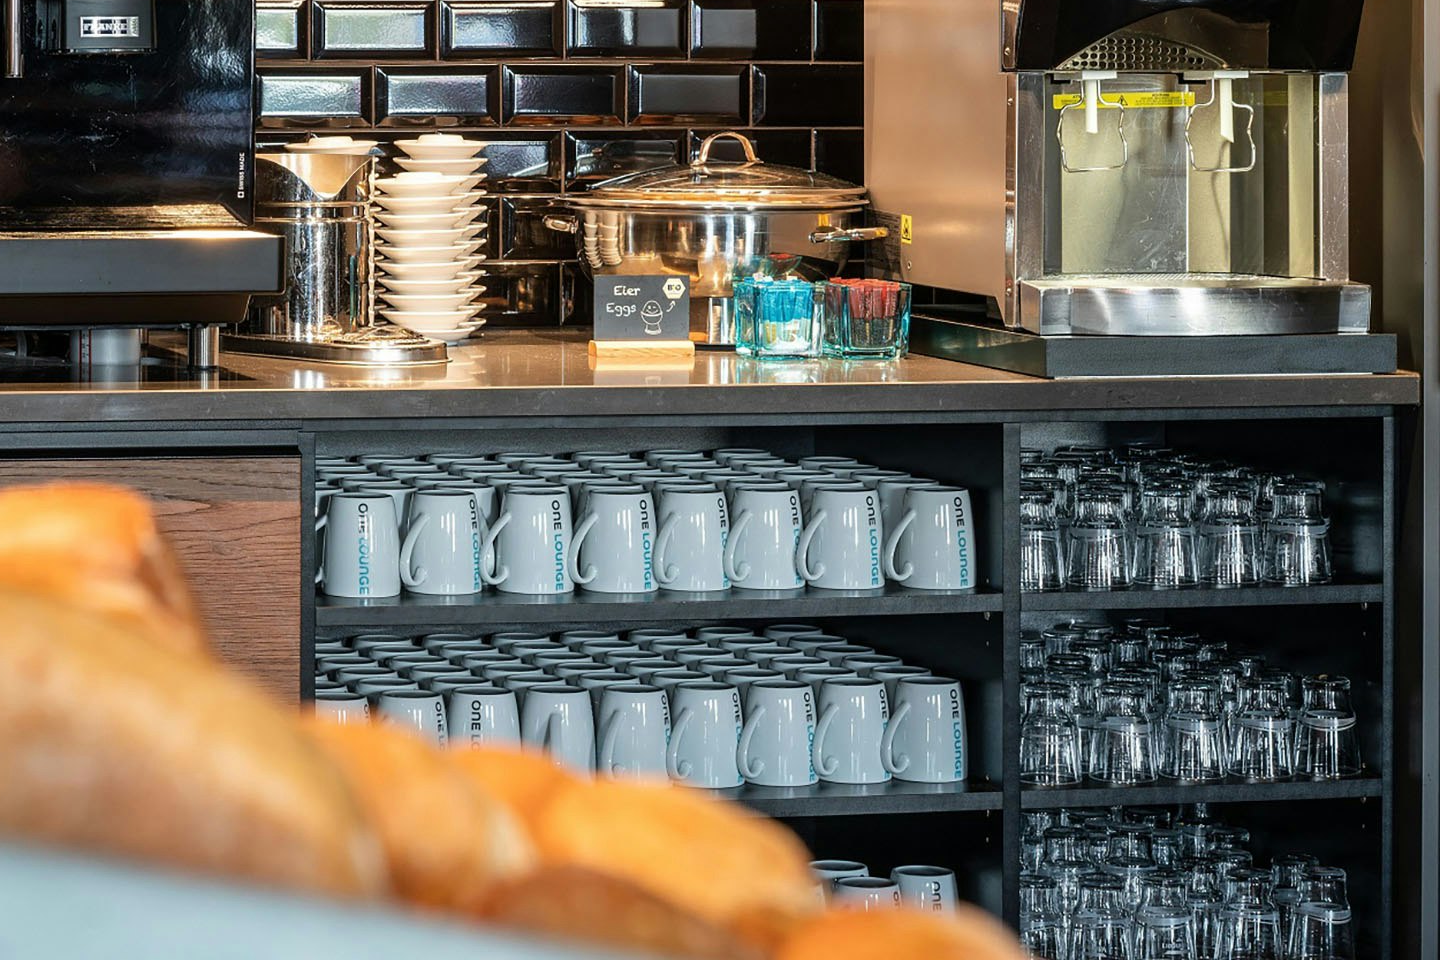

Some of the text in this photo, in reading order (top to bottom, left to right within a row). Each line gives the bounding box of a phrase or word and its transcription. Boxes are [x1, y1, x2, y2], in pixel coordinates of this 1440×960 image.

[613, 285, 640, 296] Eier
[606, 302, 637, 317] Eggs
[469, 499, 479, 530] ONE
[717, 497, 727, 528] ONE
[790, 495, 800, 526] ONE
[551, 499, 565, 591] ONE LOUNGE
[639, 499, 653, 590] ONE LOUNGE
[866, 496, 880, 587] ONE LOUNGE
[953, 496, 969, 587] ONE LOUNGE
[471, 700, 481, 731] ONE
[661, 694, 670, 725] ONE
[732, 692, 742, 723] ONE
[803, 692, 813, 722] ONE
[879, 689, 889, 719] ONE
[950, 689, 962, 779] ONE LOUNGE
